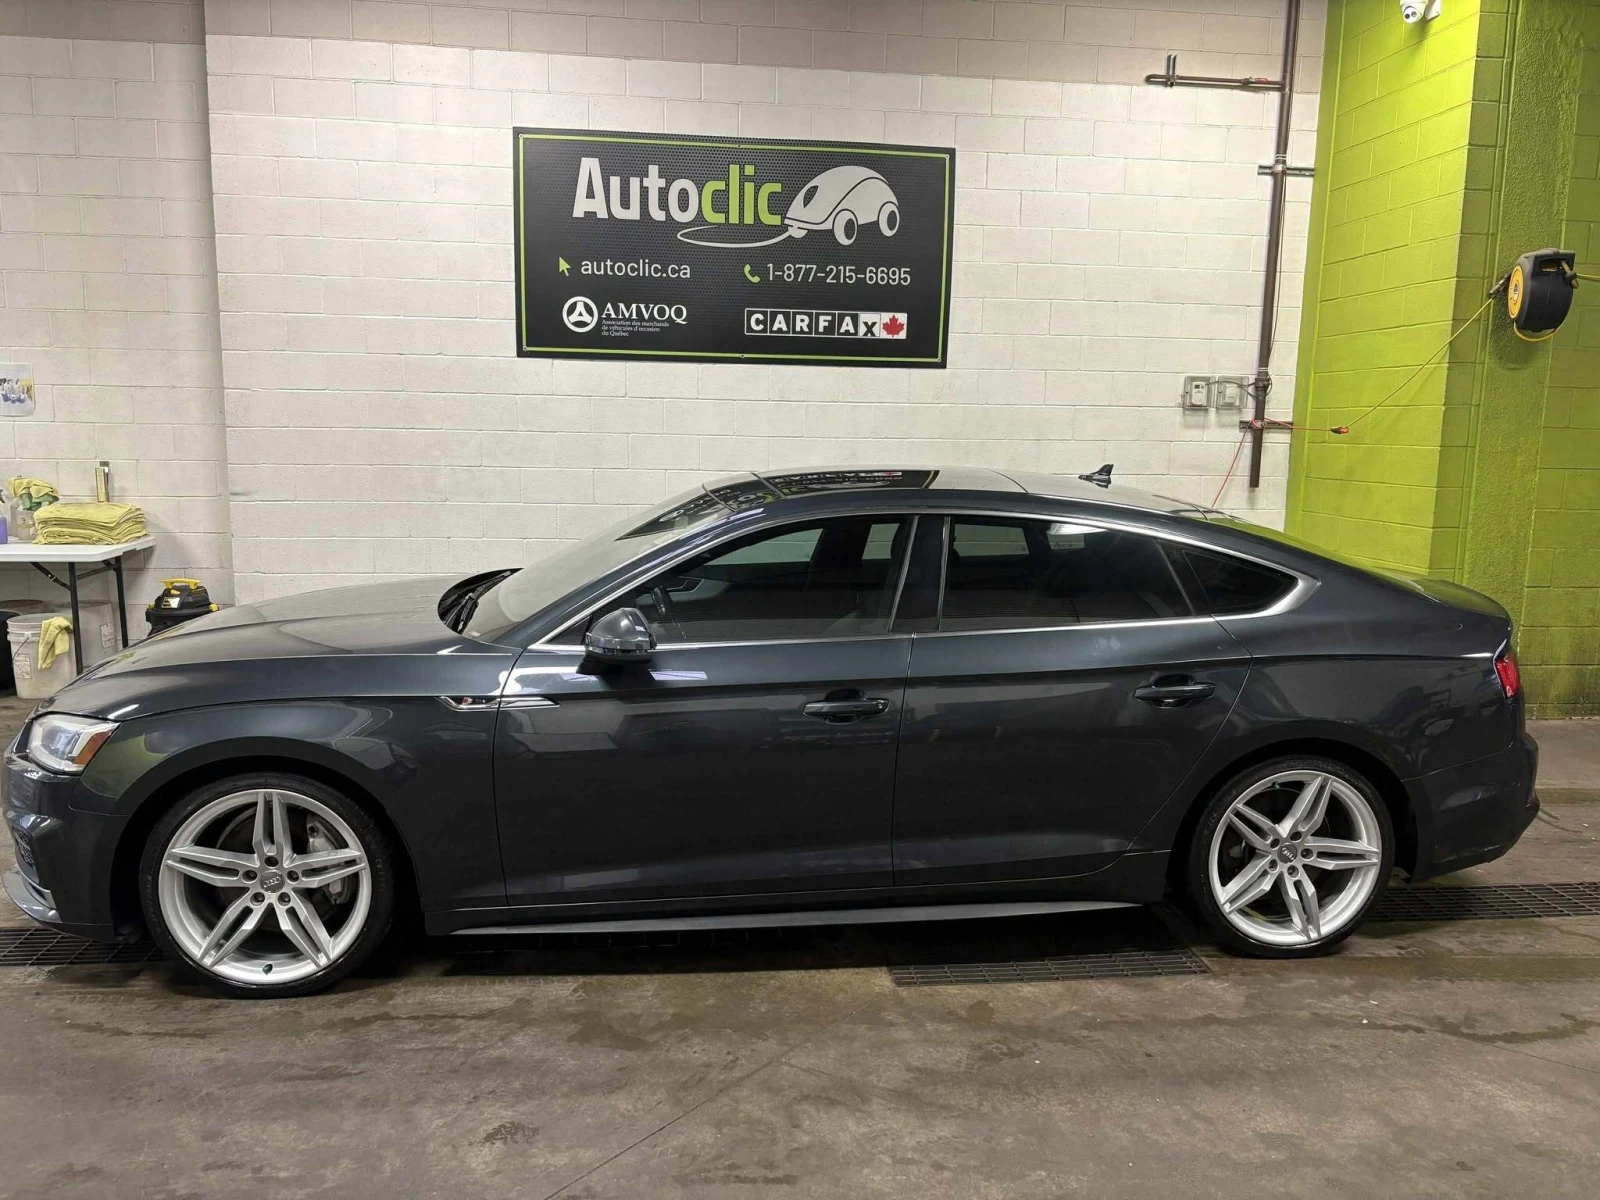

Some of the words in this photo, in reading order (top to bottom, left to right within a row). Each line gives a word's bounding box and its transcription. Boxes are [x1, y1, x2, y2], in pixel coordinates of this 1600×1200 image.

[572, 157, 782, 226] Autoclic
[580, 258, 691, 279] autoclic.ca
[766, 263, 912, 286] 1-877-215-6695
[601, 302, 687, 324] AMVOQ
[750, 313, 877, 337] CARFAX
